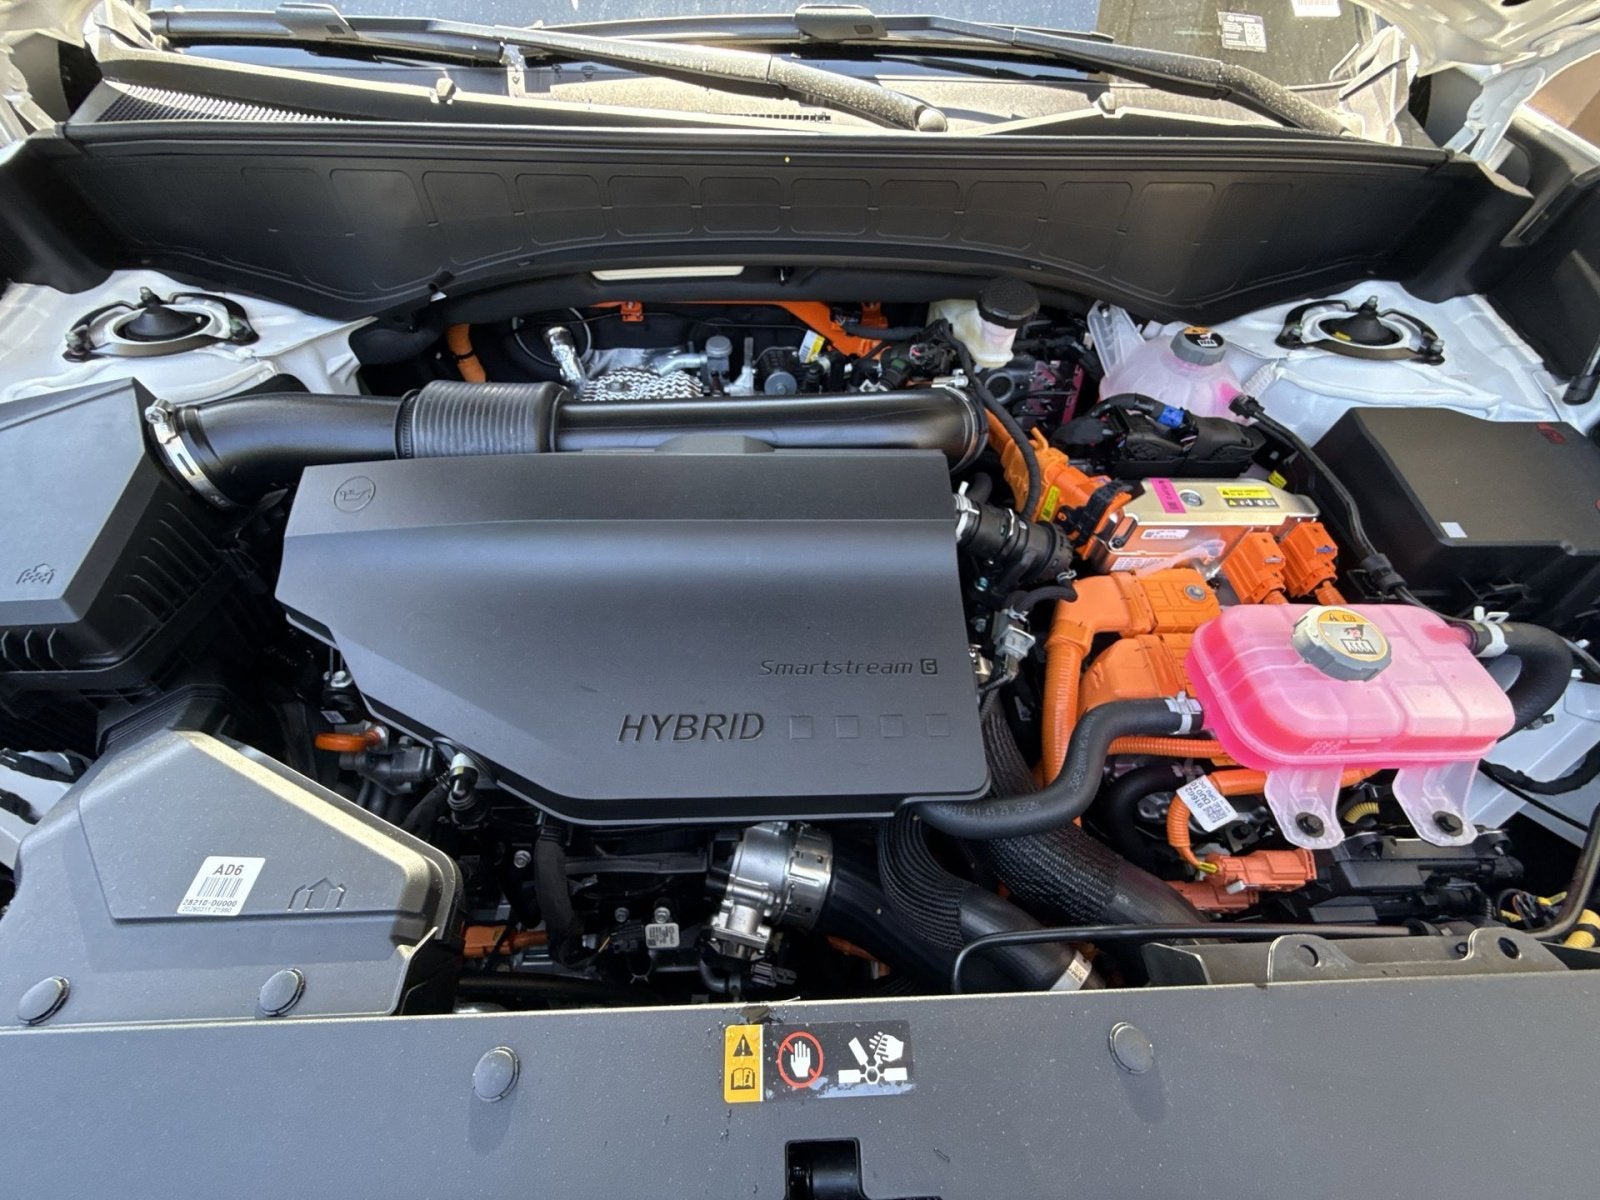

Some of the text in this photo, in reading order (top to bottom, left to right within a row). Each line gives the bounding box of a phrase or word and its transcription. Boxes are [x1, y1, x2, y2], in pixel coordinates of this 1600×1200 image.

[759, 659, 912, 676] Smartstream
[617, 712, 765, 742] HYBRID
[213, 863, 245, 876] AD6
[182, 898, 238, 907] 28210-DU000
